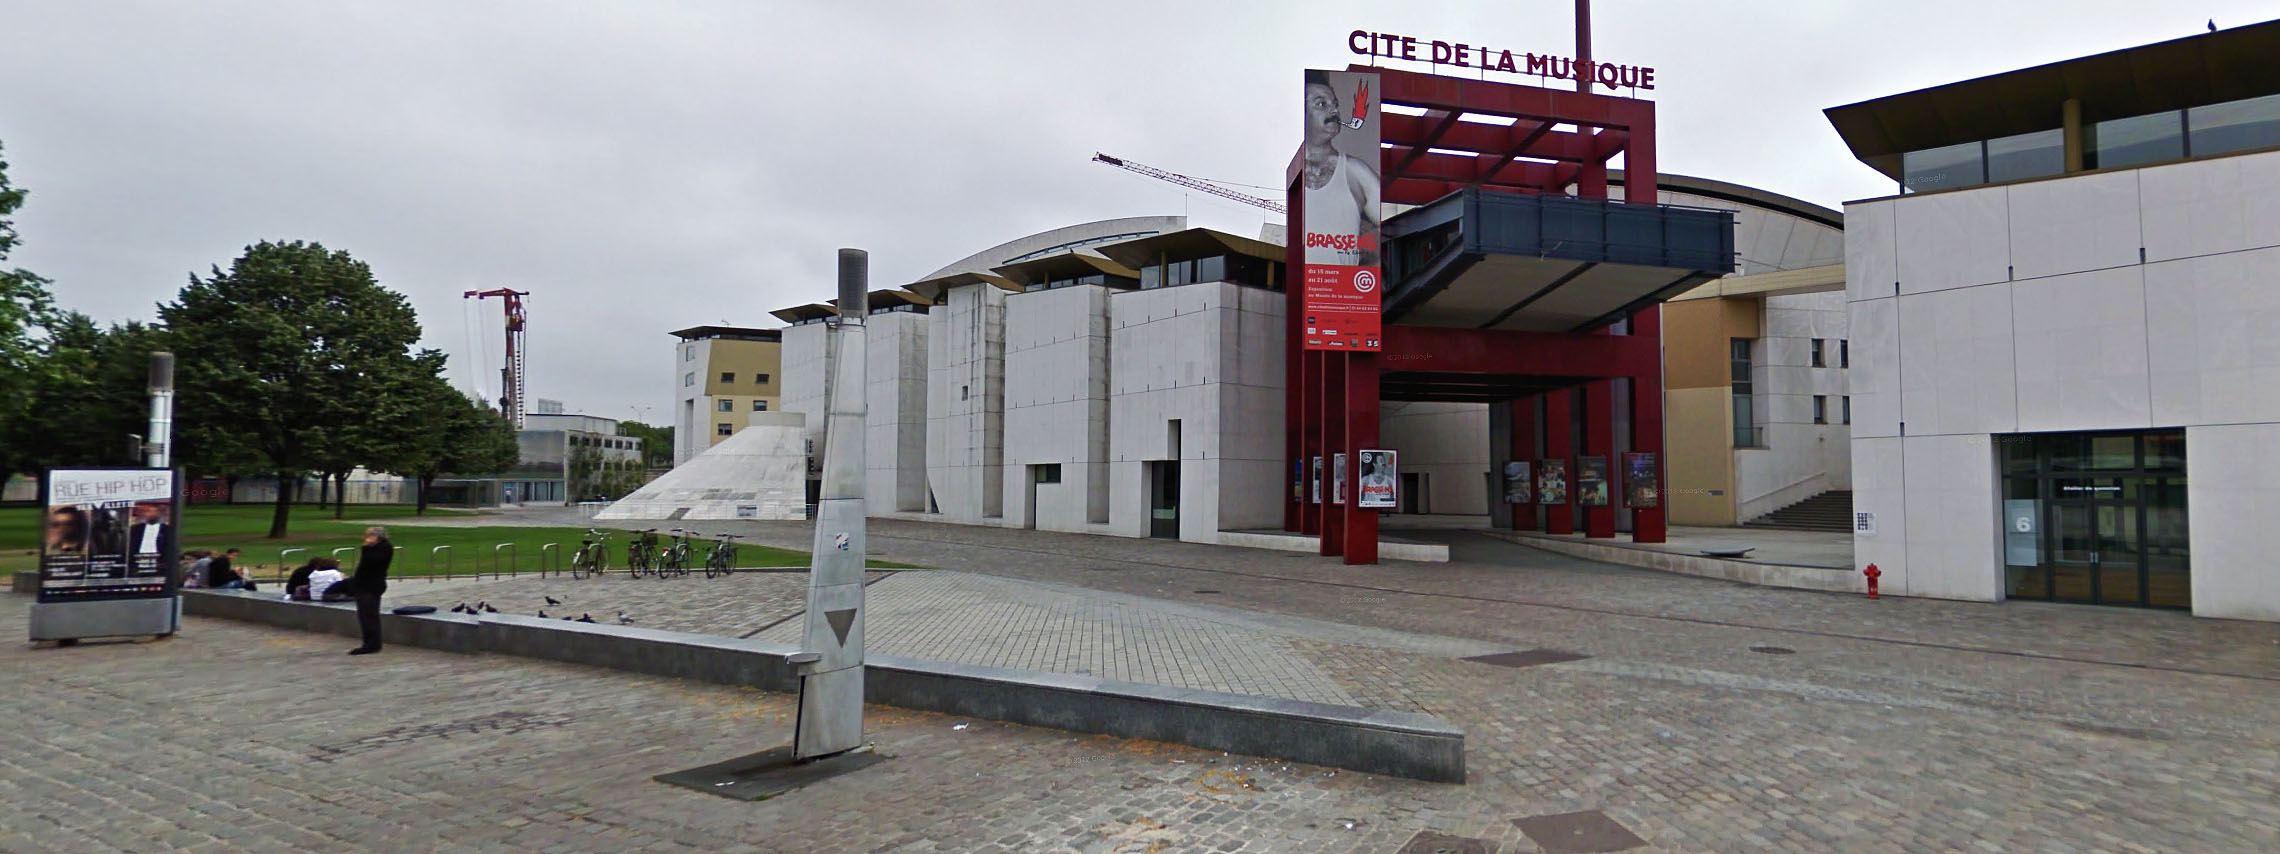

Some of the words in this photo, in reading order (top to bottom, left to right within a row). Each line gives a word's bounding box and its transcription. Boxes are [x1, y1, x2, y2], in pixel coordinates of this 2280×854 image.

[1349, 30, 1416, 61] CITE
[1432, 40, 1469, 67] DE
[1481, 46, 1517, 73] LA
[1526, 52, 1655, 90] MUSIQUE
[1306, 232, 1377, 252] BRASSENS
[95, 480, 124, 495] HIP
[130, 477, 167, 493] HOP
[2015, 516, 2032, 533] 6
